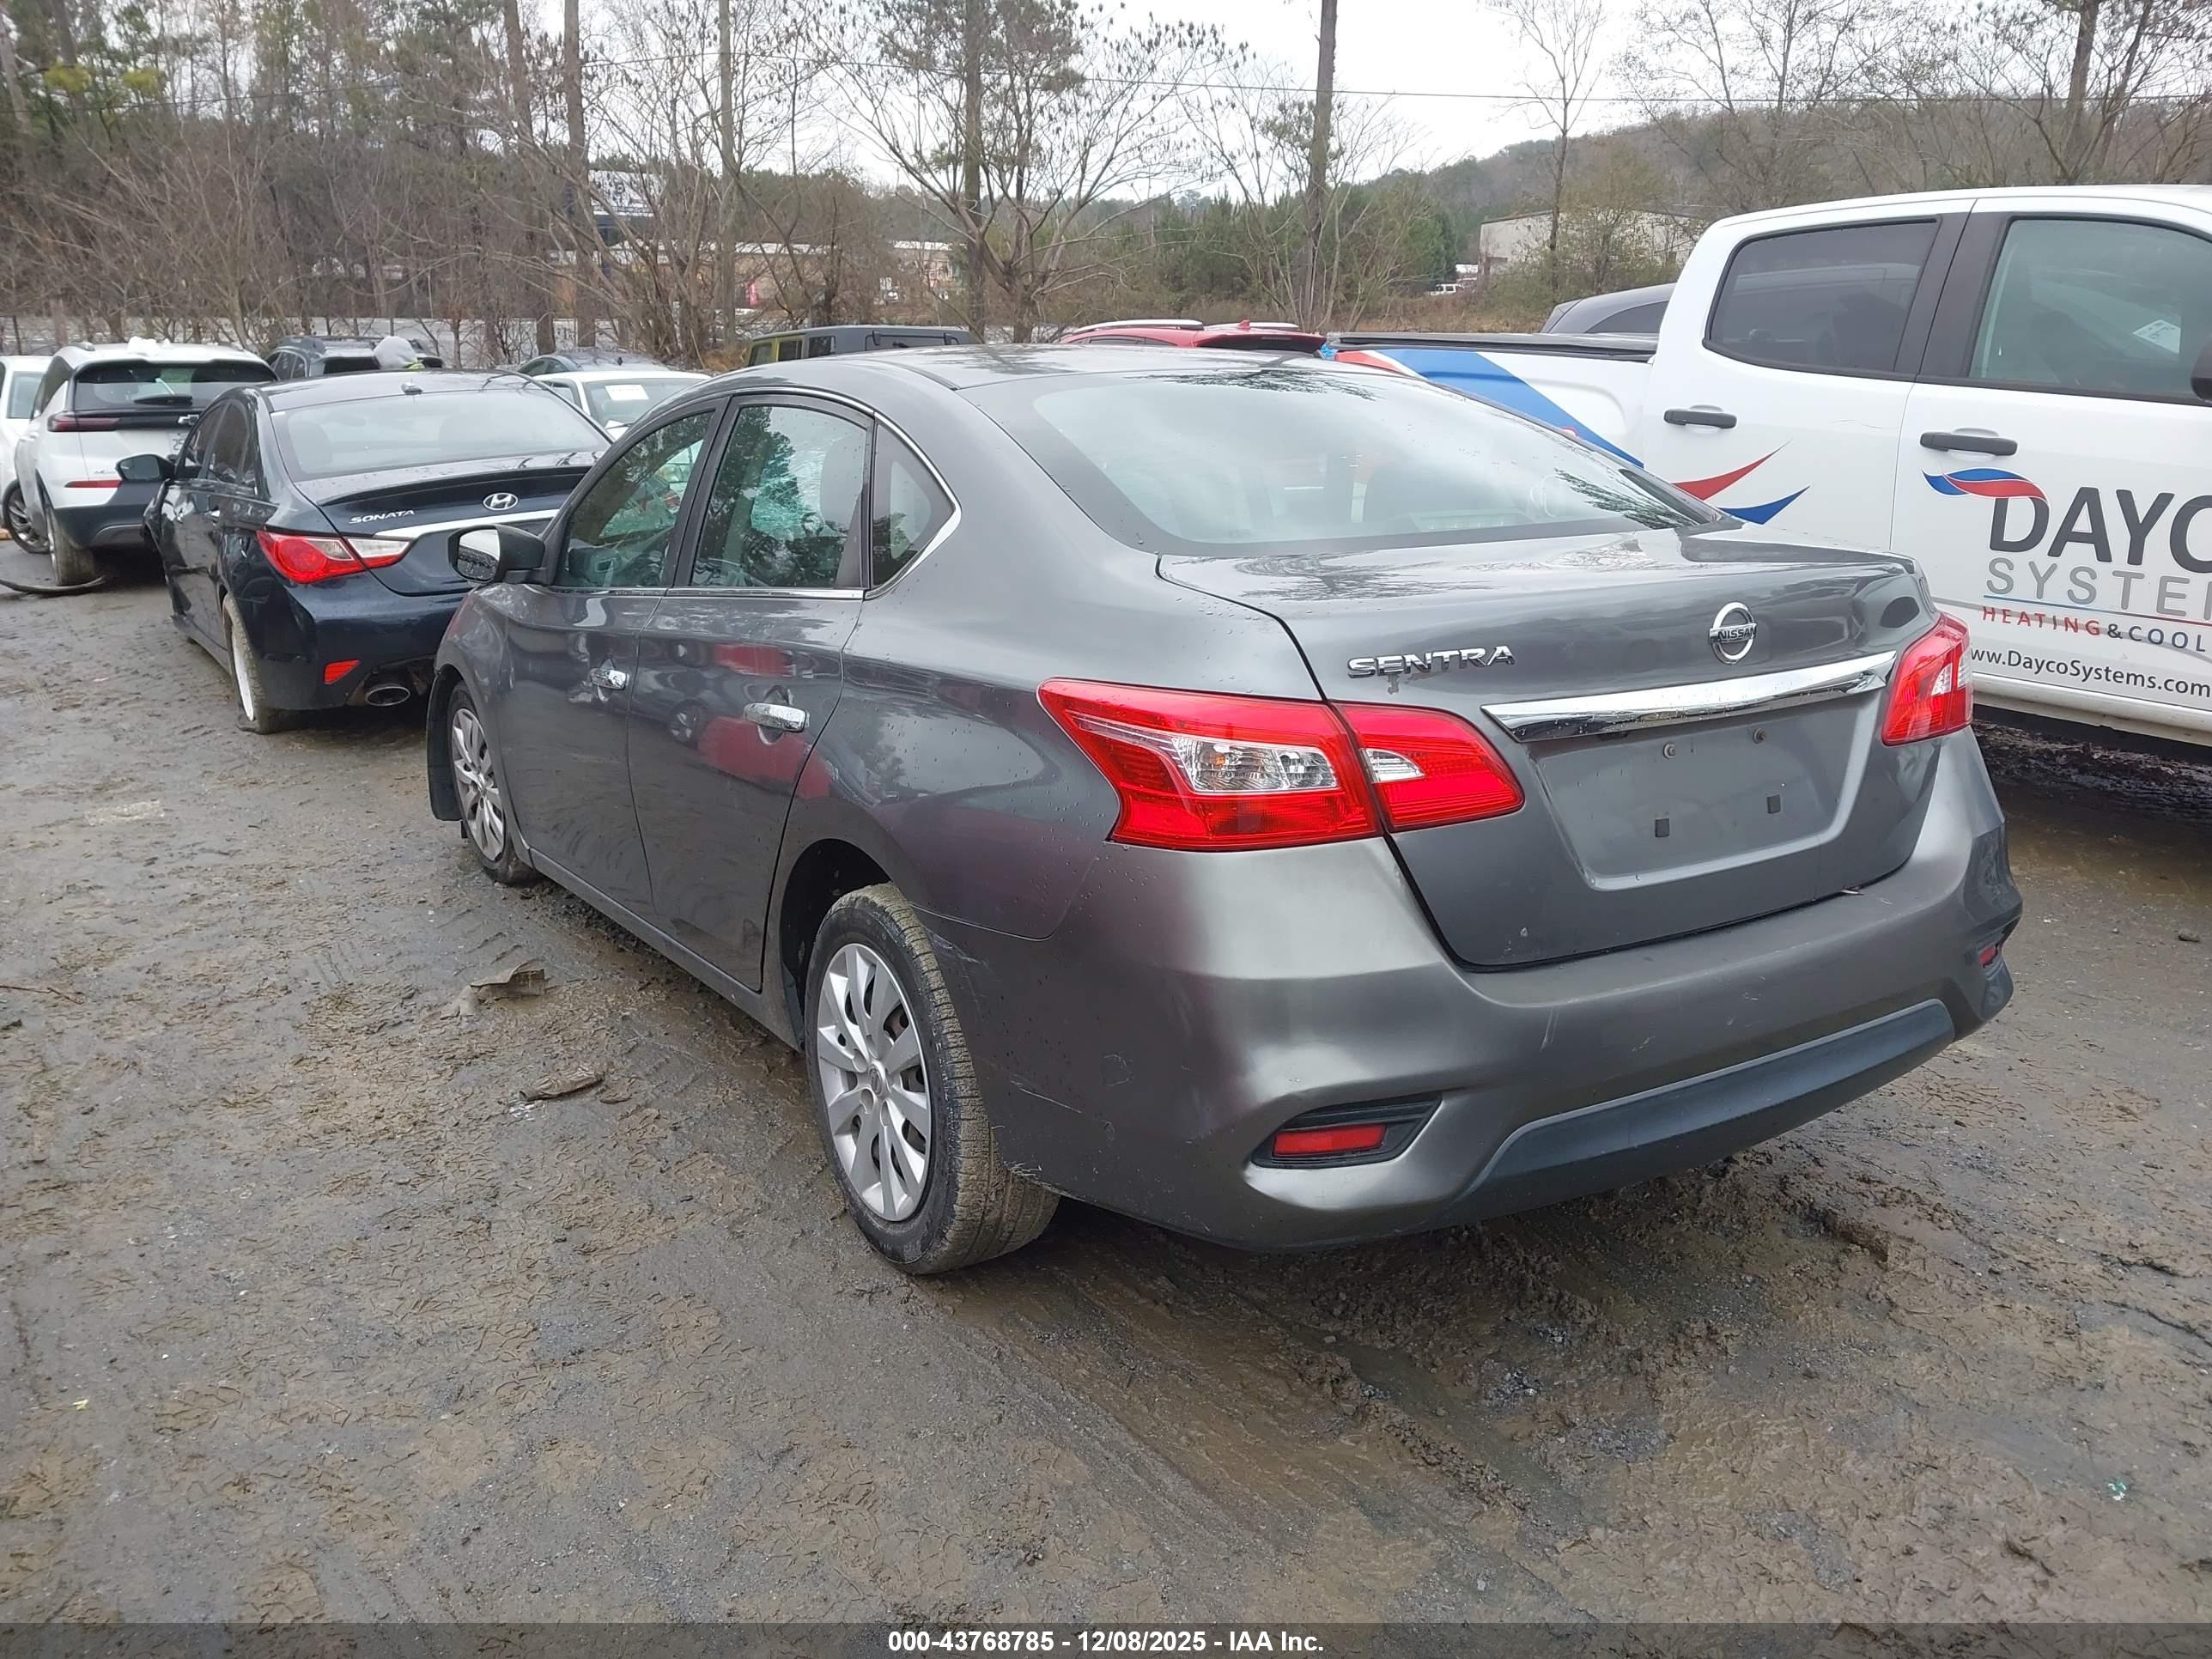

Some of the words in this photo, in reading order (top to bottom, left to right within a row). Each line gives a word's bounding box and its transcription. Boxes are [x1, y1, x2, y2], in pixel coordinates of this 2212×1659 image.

[349, 509, 415, 525] SONATA
[1986, 556, 2212, 621] SYSTE
[1717, 626, 1757, 640] NISSAN
[1348, 645, 1515, 678] SENTRA
